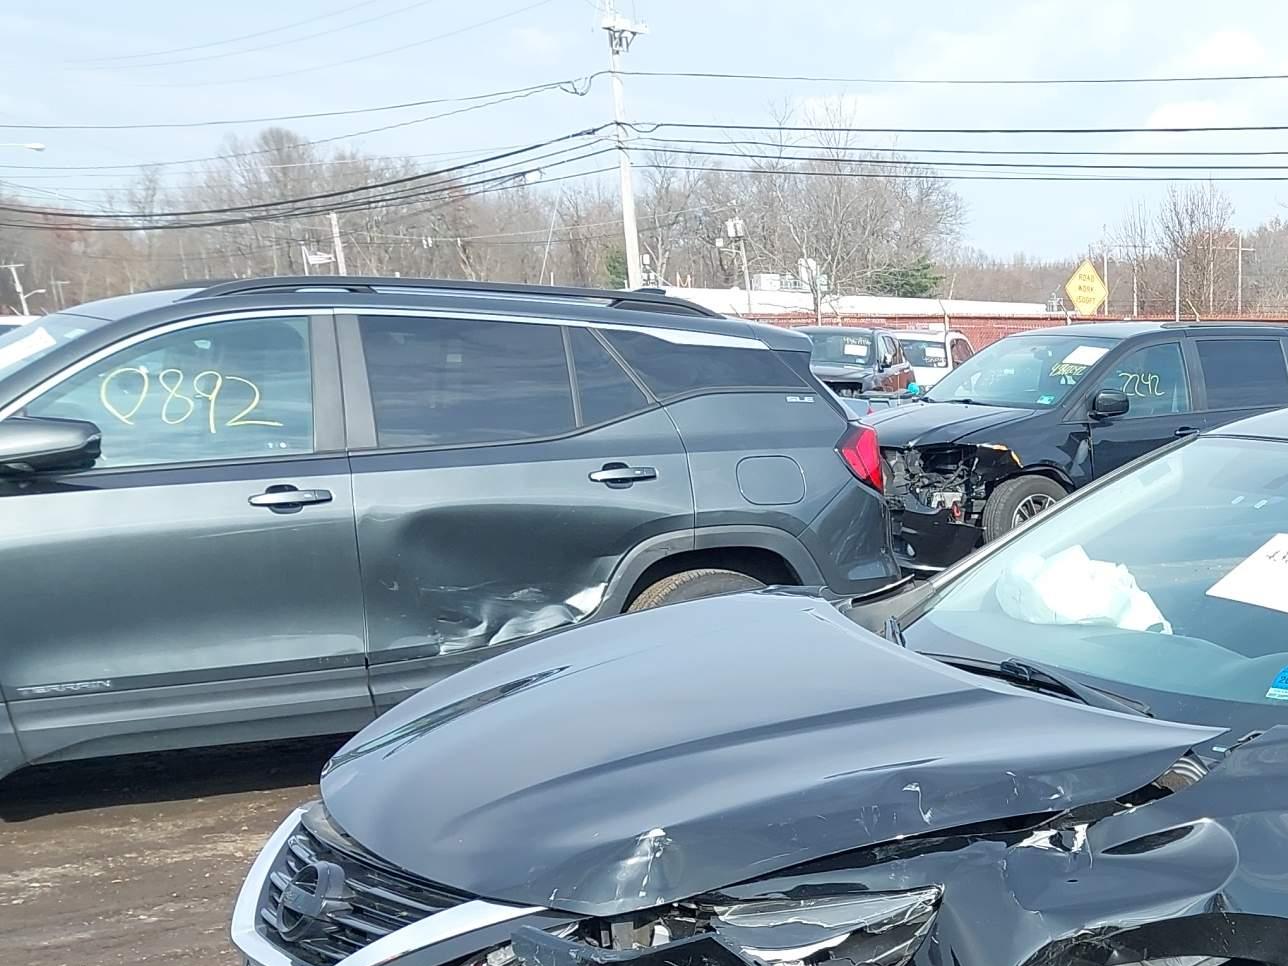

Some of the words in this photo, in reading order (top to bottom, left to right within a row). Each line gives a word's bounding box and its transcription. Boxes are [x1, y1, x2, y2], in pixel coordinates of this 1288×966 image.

[1078, 273, 1095, 282] ROAD
[1077, 284, 1095, 293] WORK
[101, 367, 284, 433] 0892
